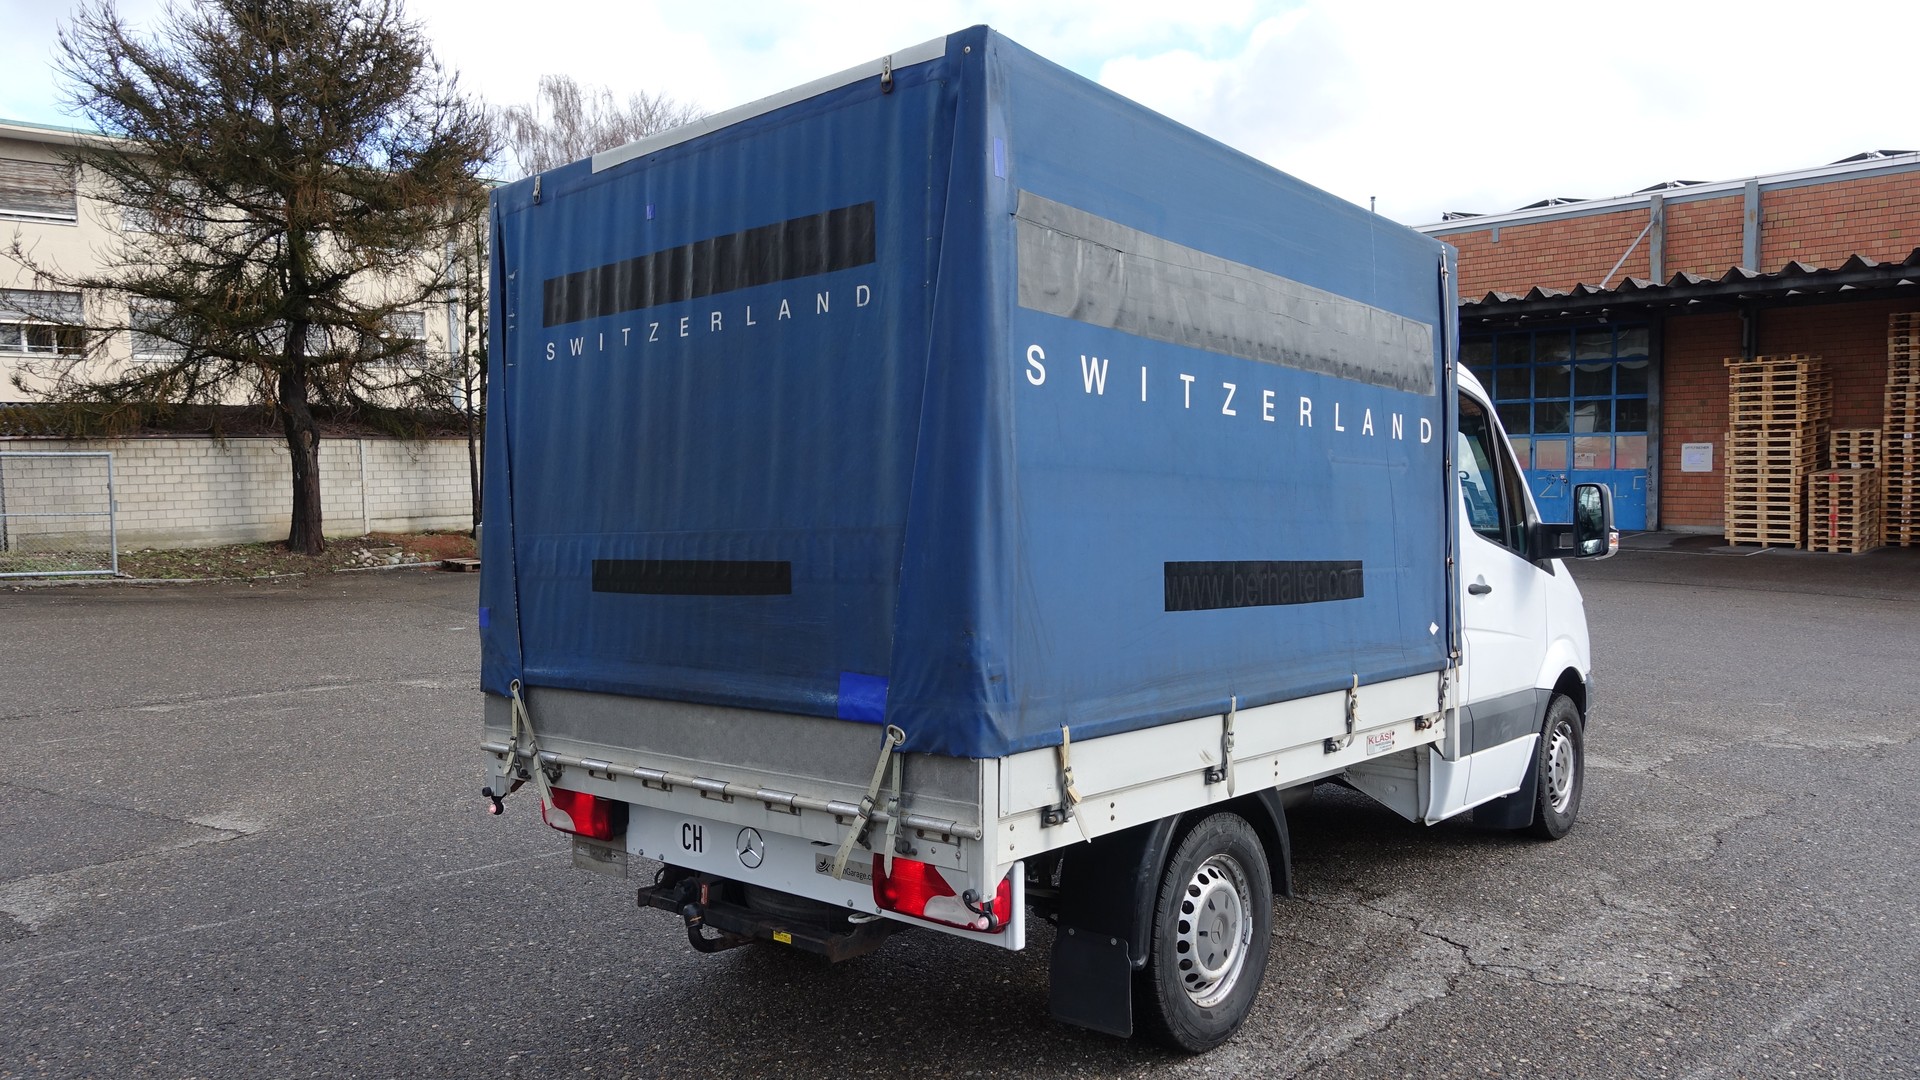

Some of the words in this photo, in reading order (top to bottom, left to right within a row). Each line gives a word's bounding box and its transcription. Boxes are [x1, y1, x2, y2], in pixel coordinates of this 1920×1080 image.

[546, 285, 870, 360] SWITZERLAND
[1026, 344, 1431, 443] SWITZERLAND
[682, 822, 703, 853] CH
